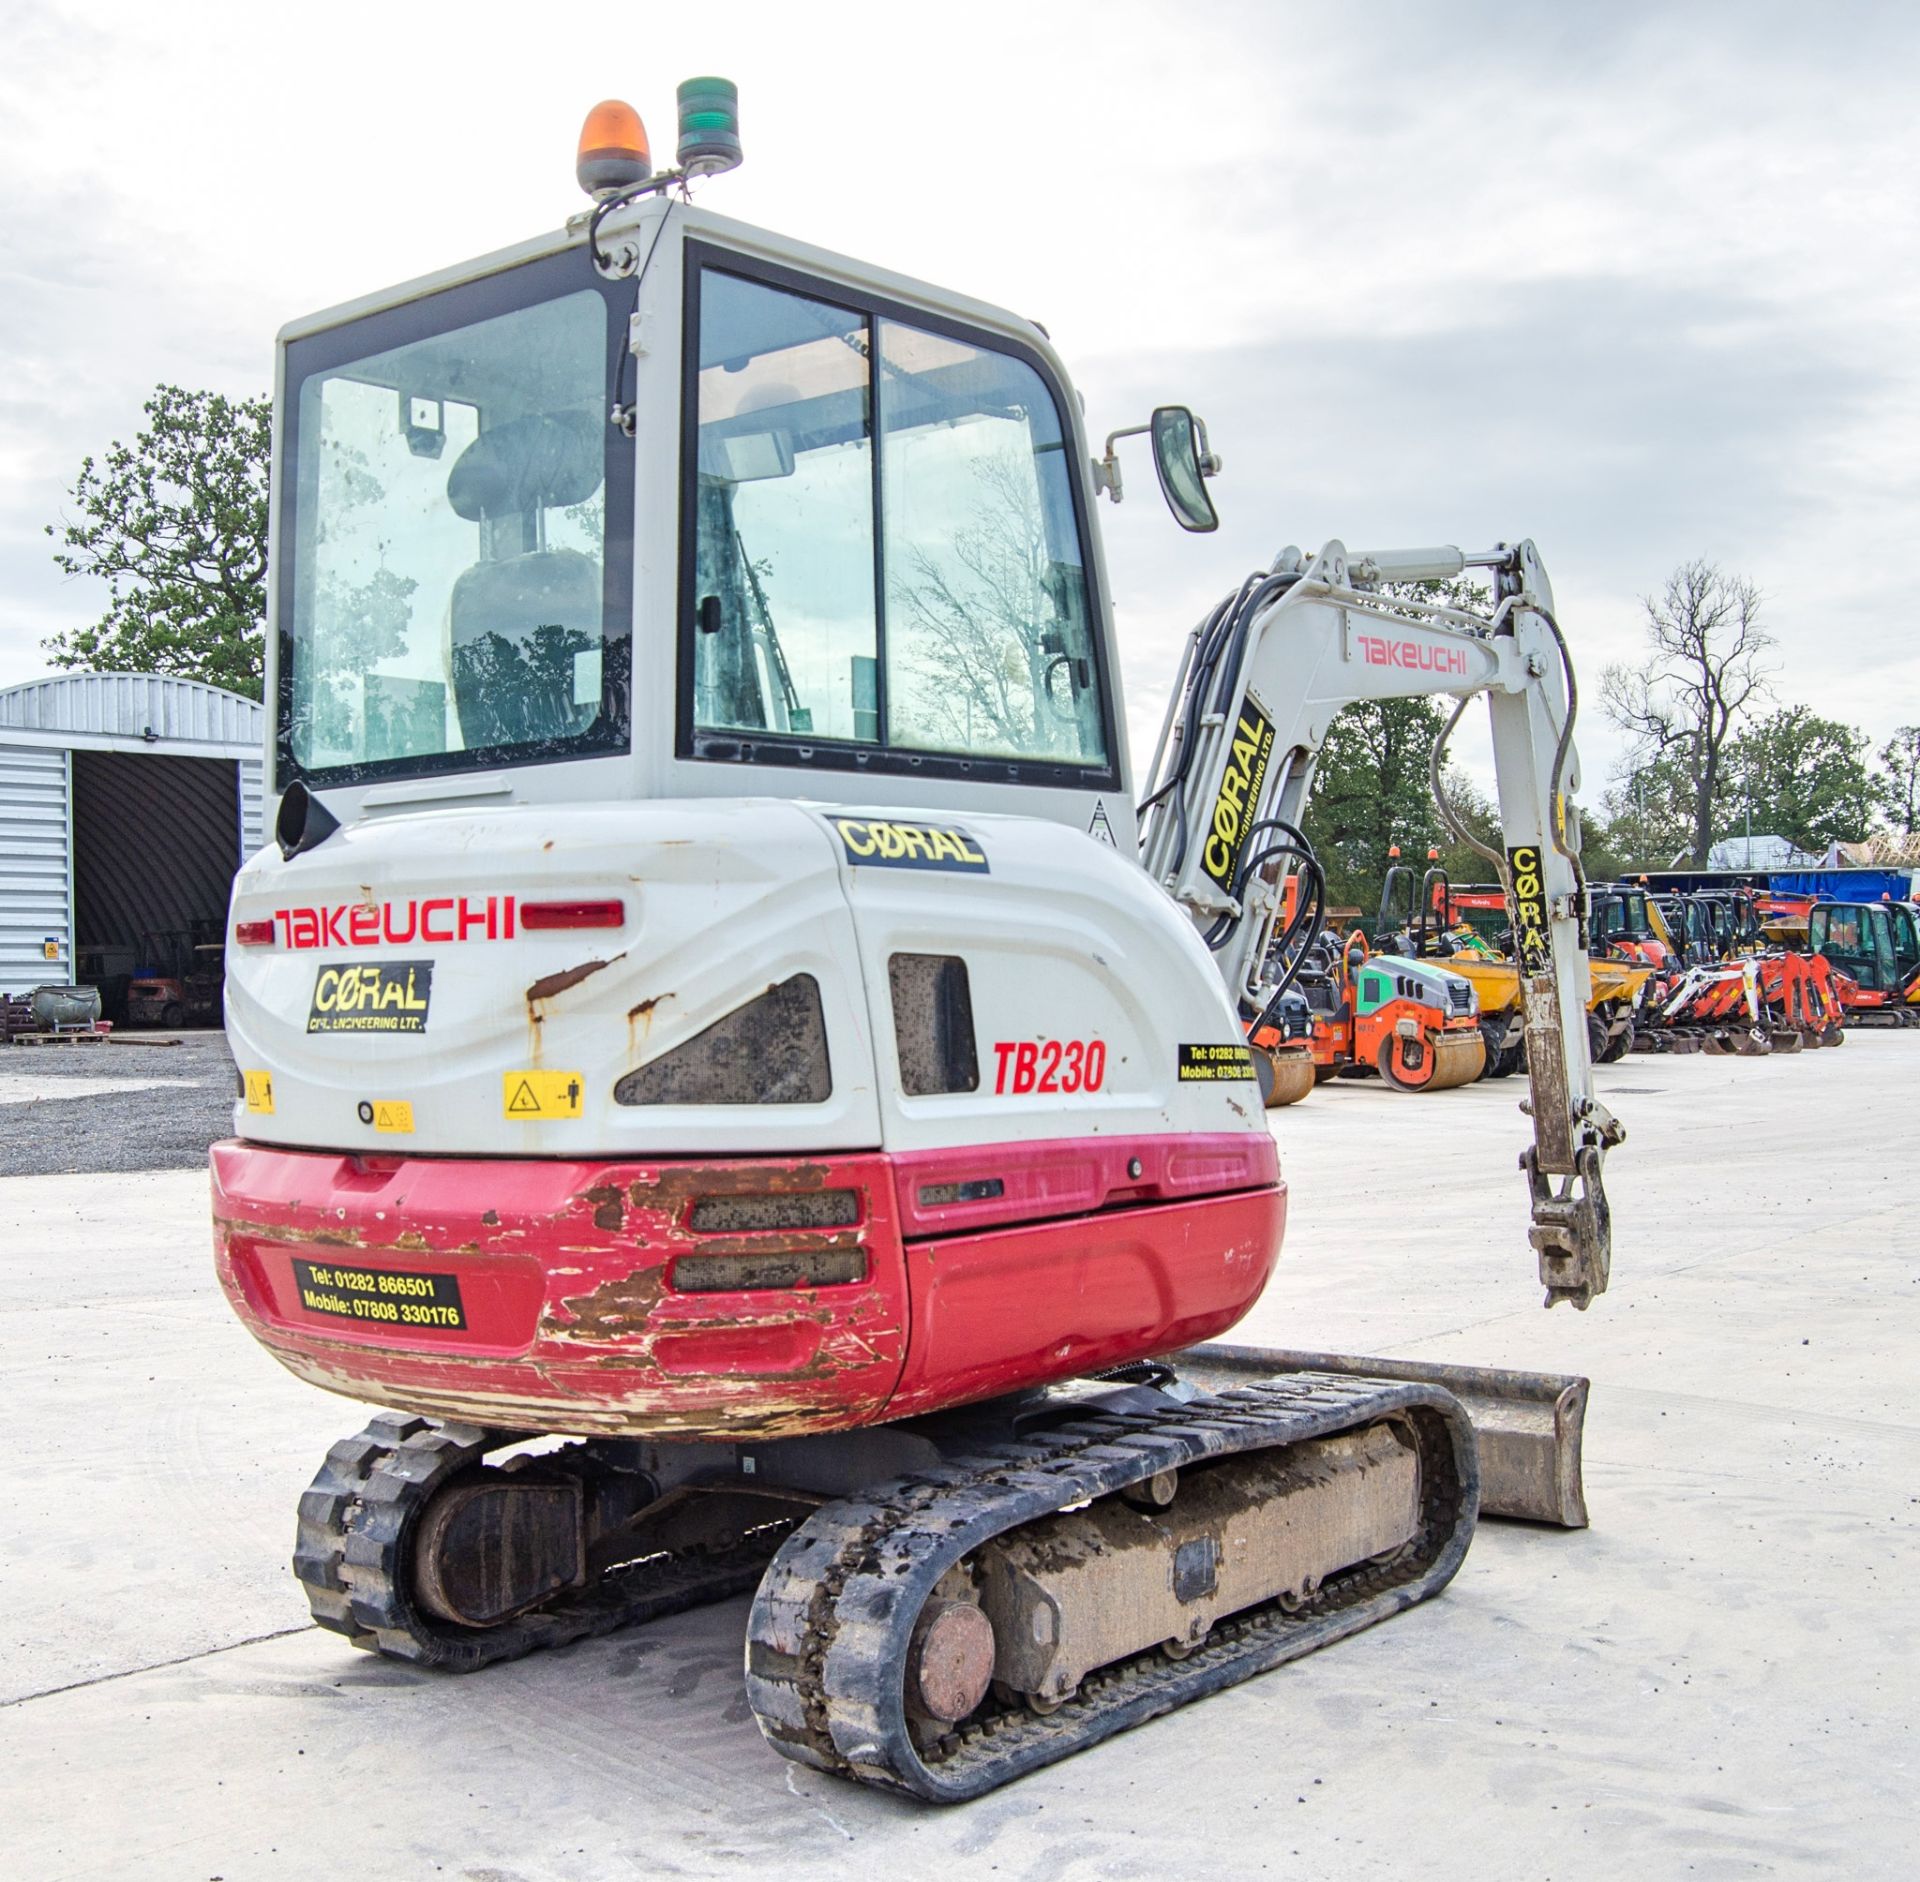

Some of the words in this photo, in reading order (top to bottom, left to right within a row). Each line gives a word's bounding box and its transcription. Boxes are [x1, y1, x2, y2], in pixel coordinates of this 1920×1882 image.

[1357, 635, 1467, 675] TAKEUCHI
[1262, 731, 1273, 758] LTD.
[274, 896, 515, 949] TAKEUCHI
[993, 1040, 1106, 1095] TB230
[1190, 1047, 1207, 1060] Tel:
[1209, 1047, 1234, 1060] 01282
[1181, 1065, 1216, 1079] Mobile:
[309, 1266, 333, 1286] Tel:
[335, 1271, 376, 1292] 01282
[378, 1277, 435, 1297] 866501
[303, 1290, 352, 1315] Mobile:
[353, 1299, 398, 1320] 07808
[400, 1305, 460, 1326] 330176
